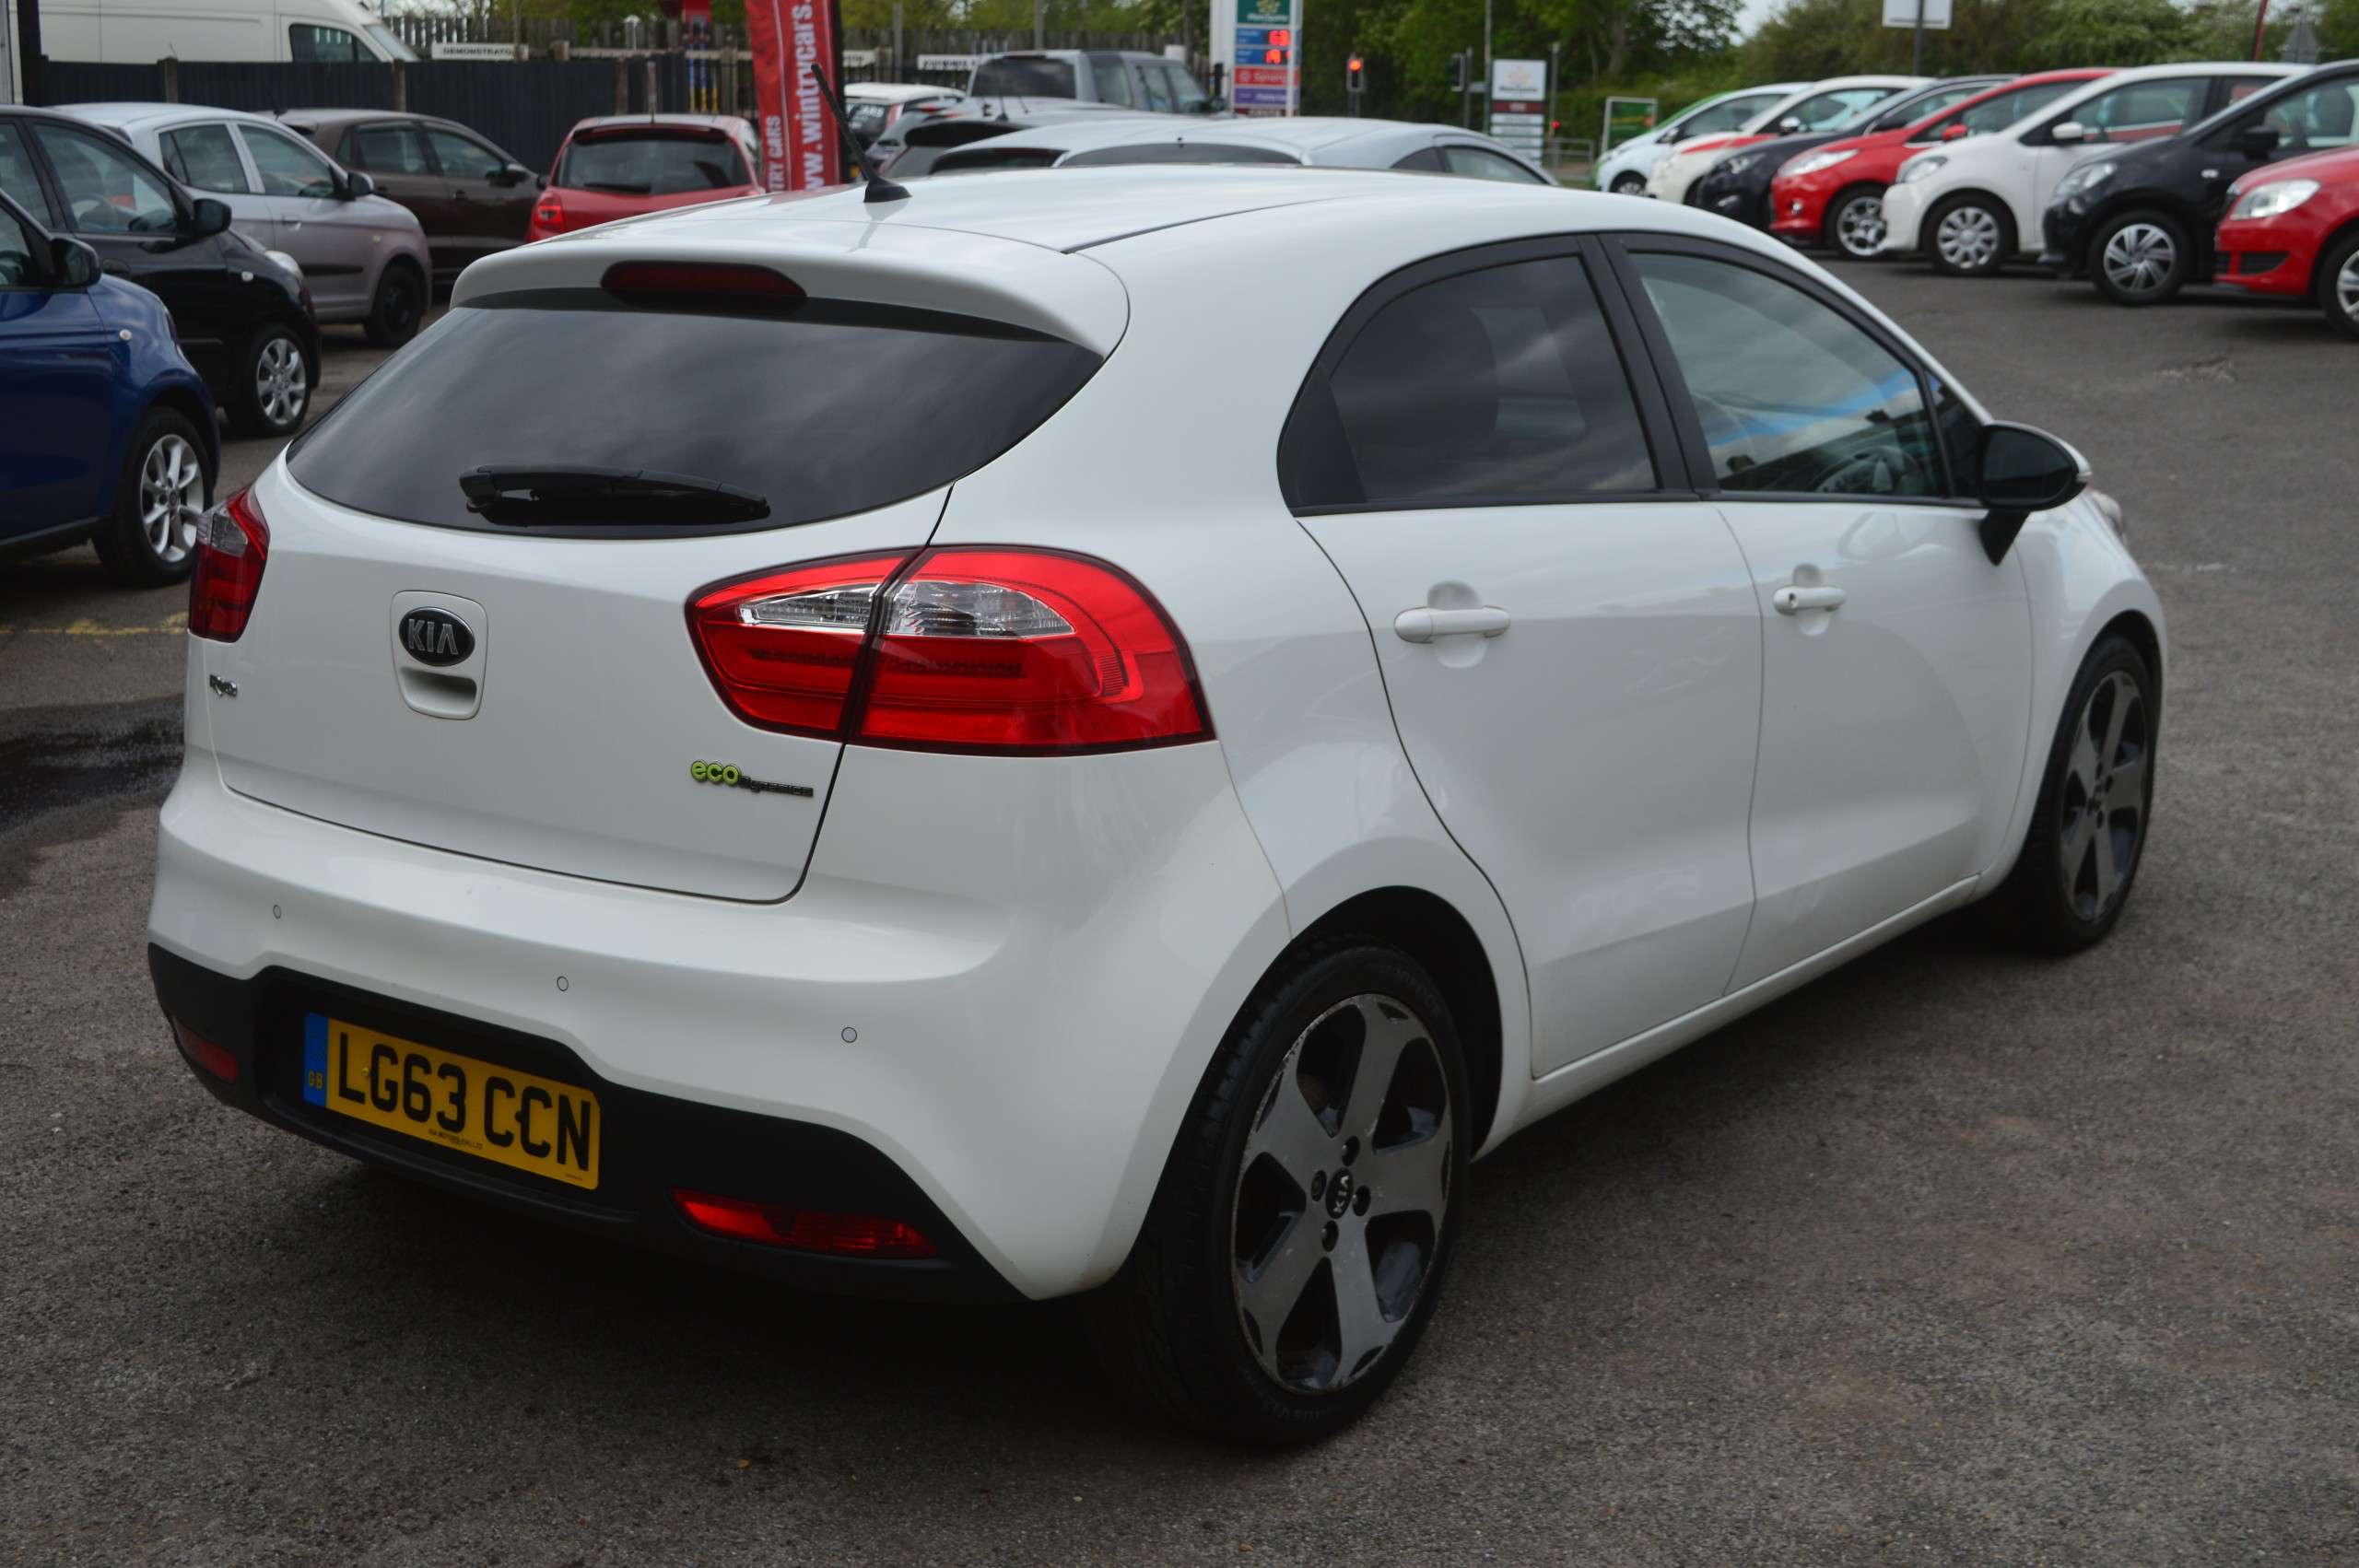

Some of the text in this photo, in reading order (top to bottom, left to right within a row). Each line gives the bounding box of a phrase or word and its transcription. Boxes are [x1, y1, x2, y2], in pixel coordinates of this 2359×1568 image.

[443, 47, 513, 55] DEMONSTRATO
[766, 115, 785, 191] TRY CARS
[408, 618, 459, 655] KIA
[338, 1031, 592, 1172] LG63 CCN
[1332, 1175, 1349, 1214] KIA
